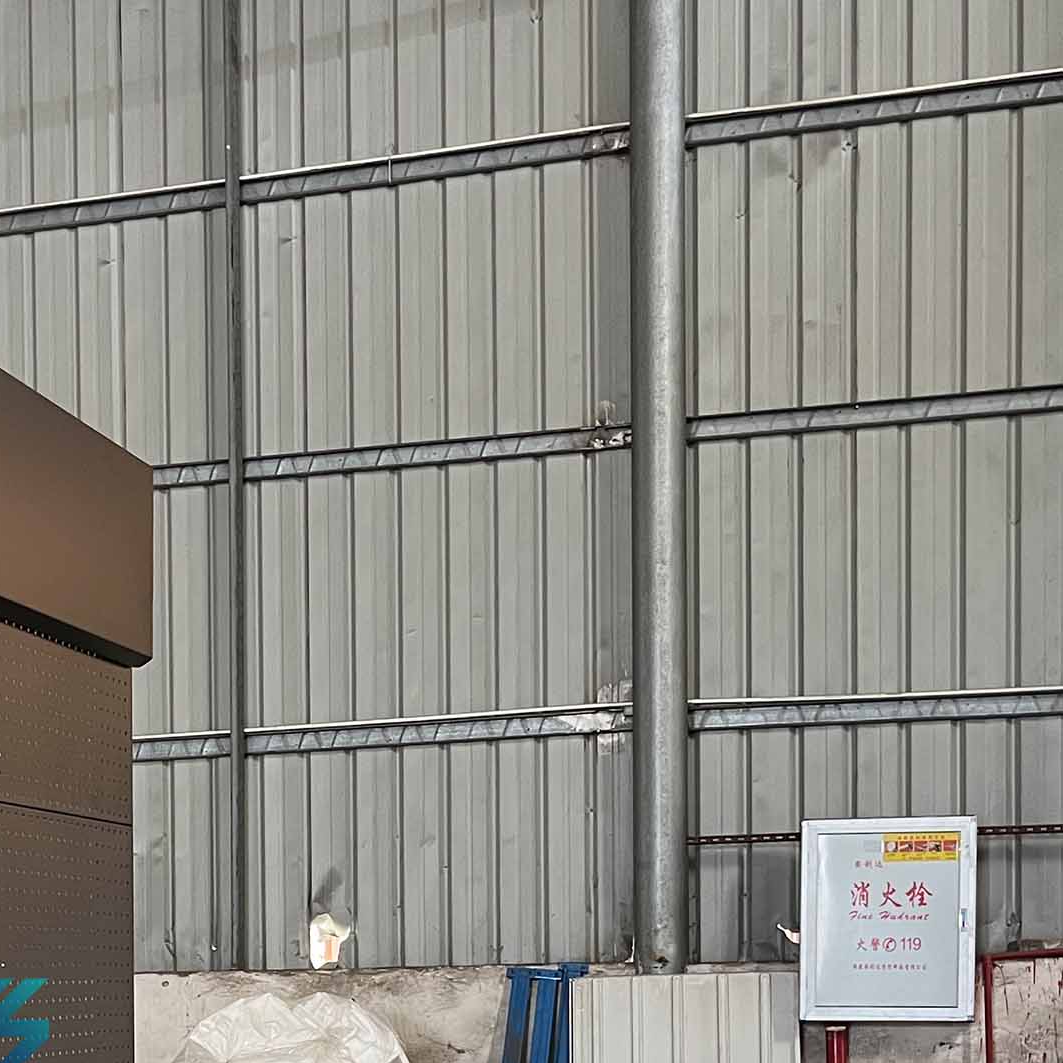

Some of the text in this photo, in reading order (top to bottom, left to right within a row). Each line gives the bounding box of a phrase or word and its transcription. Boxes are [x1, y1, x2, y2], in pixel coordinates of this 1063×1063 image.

[850, 881, 933, 908] 消火栓
[900, 937, 922, 951] 119
